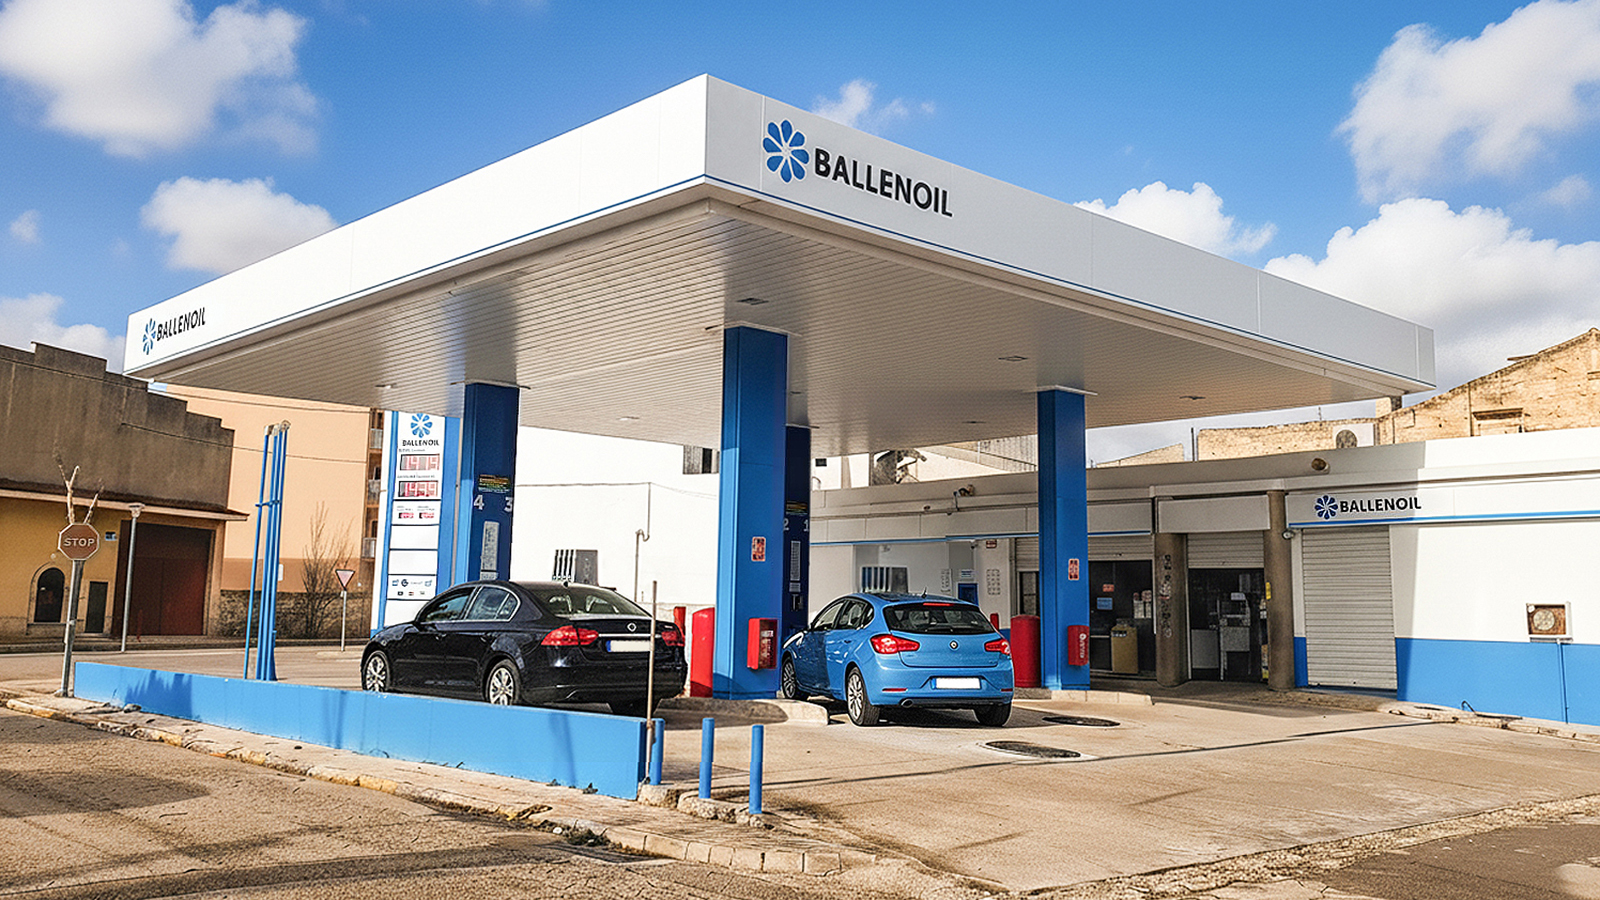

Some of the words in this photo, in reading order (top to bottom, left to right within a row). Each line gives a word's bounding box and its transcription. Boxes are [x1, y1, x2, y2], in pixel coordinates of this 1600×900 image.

[815, 148, 953, 217] BALLENOIL
[157, 307, 206, 341] BALLENOIL
[474, 494, 485, 510] 4
[504, 496, 513, 512] 3
[1340, 497, 1422, 513] BALLENOIL
[784, 518, 790, 531] 2
[803, 519, 809, 532] 1
[63, 538, 95, 547] STOP
